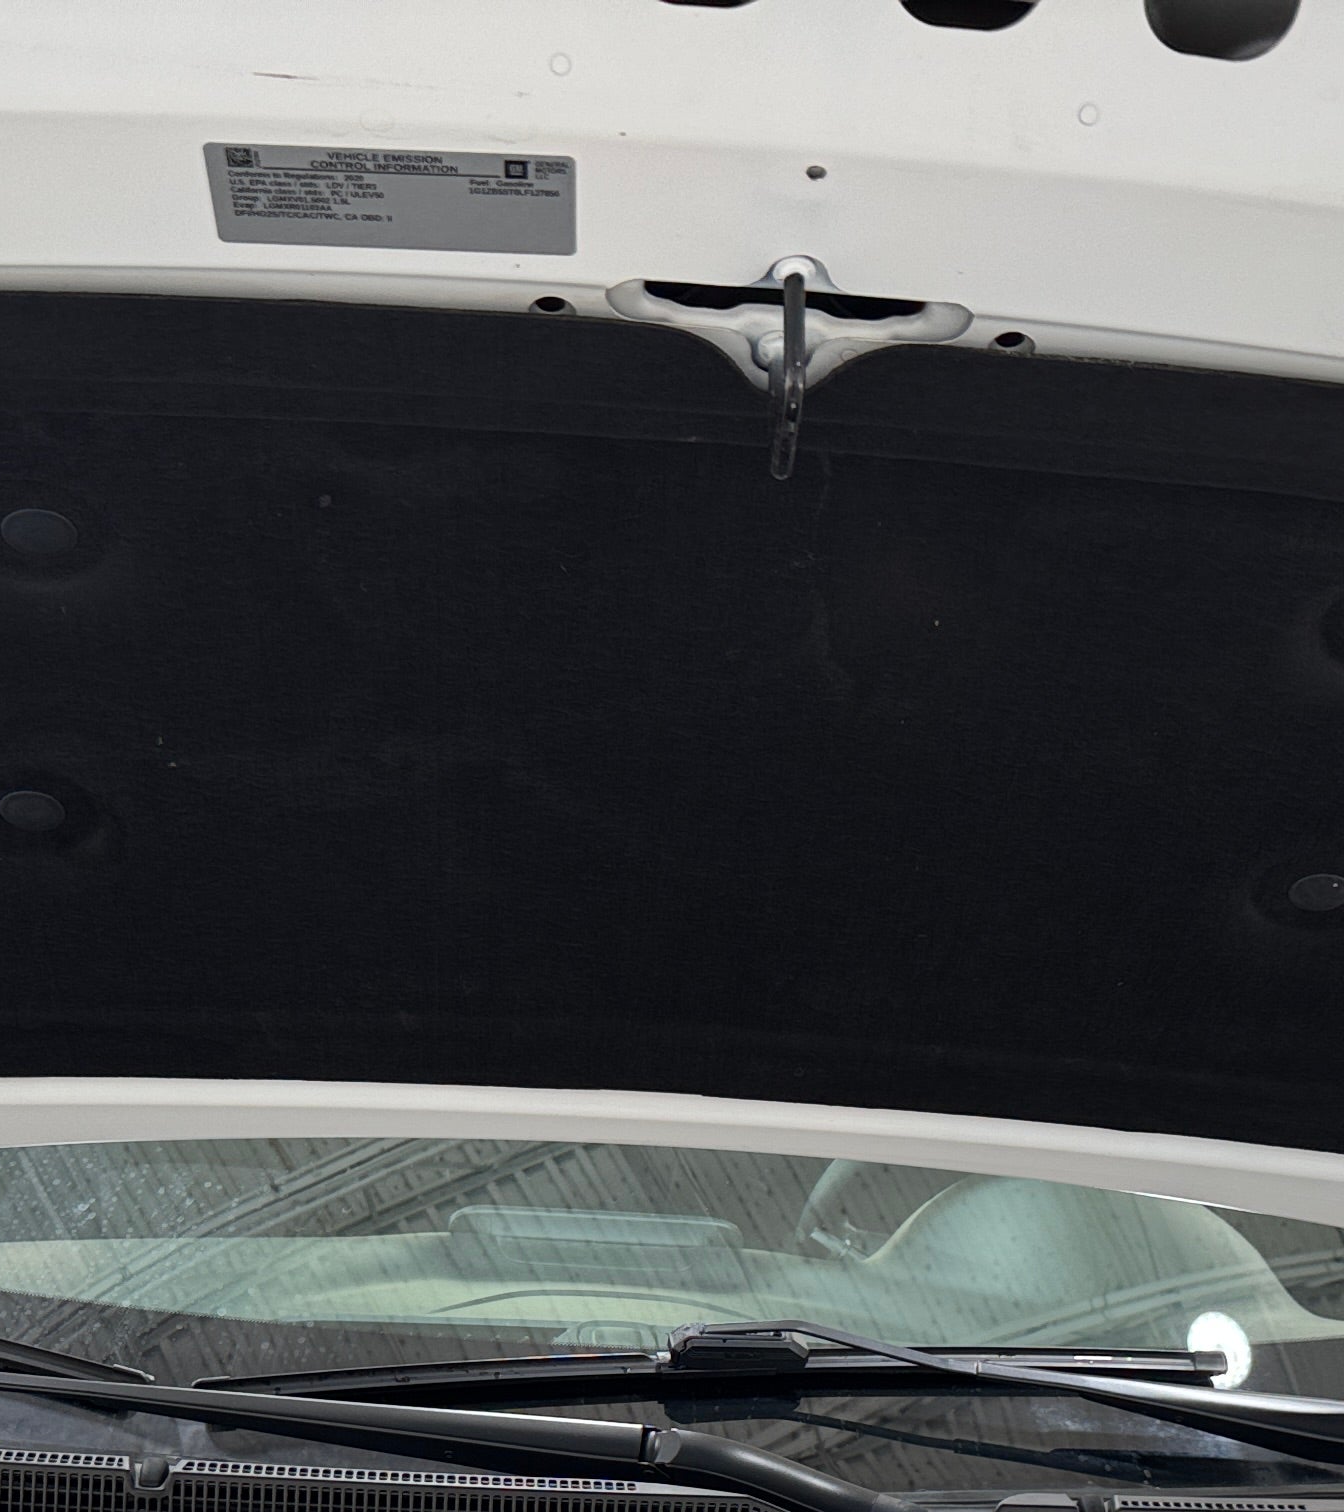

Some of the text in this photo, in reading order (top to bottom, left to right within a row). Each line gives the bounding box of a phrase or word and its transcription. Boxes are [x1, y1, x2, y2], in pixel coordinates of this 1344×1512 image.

[327, 152, 443, 164] VEHICLE EMISSION
[310, 160, 458, 174] CONTROL INFORMATION
[345, 213, 358, 221] CA
